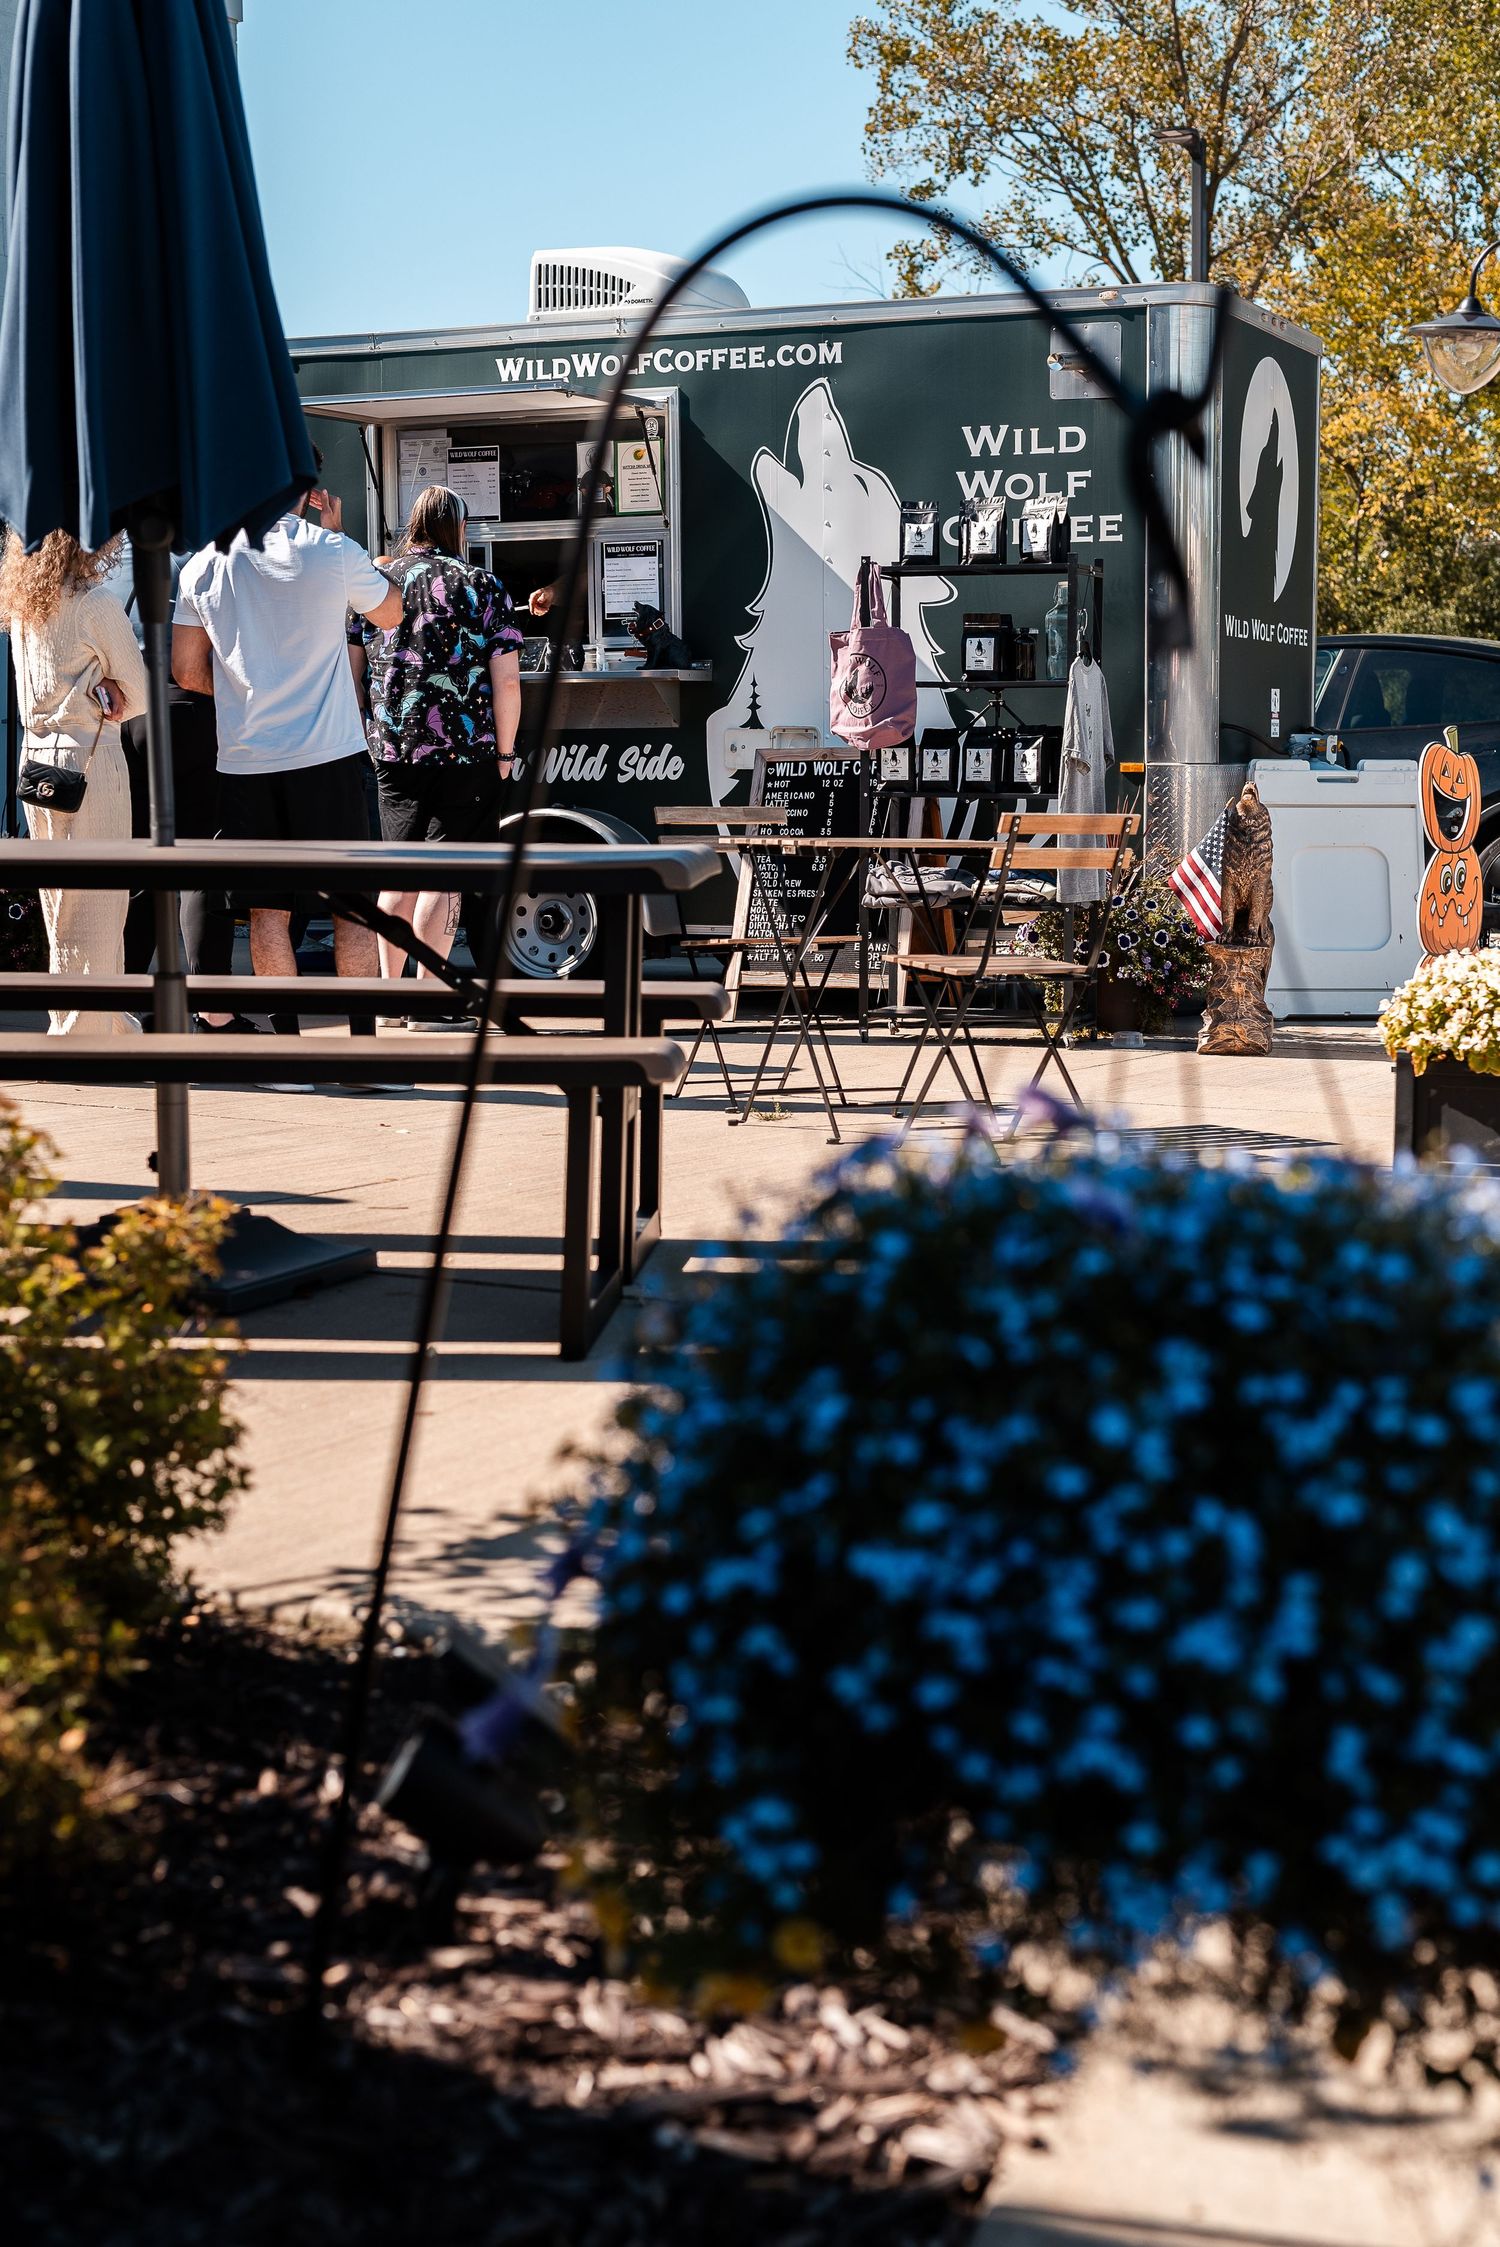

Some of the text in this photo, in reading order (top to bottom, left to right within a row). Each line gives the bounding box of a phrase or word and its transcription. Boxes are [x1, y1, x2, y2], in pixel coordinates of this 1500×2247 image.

[630, 297, 654, 305] DOMETIC
[961, 424, 1087, 457] WILD
[450, 449, 497, 459] WILD WOLF COFFEE
[955, 469, 1092, 501] WOLF
[942, 513, 1123, 547] CEE
[620, 545, 635, 553] WOLF
[635, 544, 656, 552] COFFEE
[1224, 613, 1309, 647] WILD WOLF COFFEE
[527, 743, 610, 784] Wild
[617, 743, 685, 783] Side
[775, 762, 807, 777] WILD
[813, 761, 851, 776] WOLF
[773, 780, 791, 788] HOT
[822, 779, 831, 788] 12
[833, 779, 844, 788] OZ
[764, 791, 835, 800] AMERICANO 4
[765, 799, 790, 808] LATTE
[829, 799, 835, 807] 5
[827, 808, 833, 817] 5
[779, 827, 805, 836] COCOA
[756, 855, 771, 864] TEA
[779, 879, 802, 888] REW
[787, 889, 825, 898] ESPRES
[751, 898, 779, 907] LATE
[750, 906, 776, 915] MOCA
[772, 914, 798, 922] LATE
